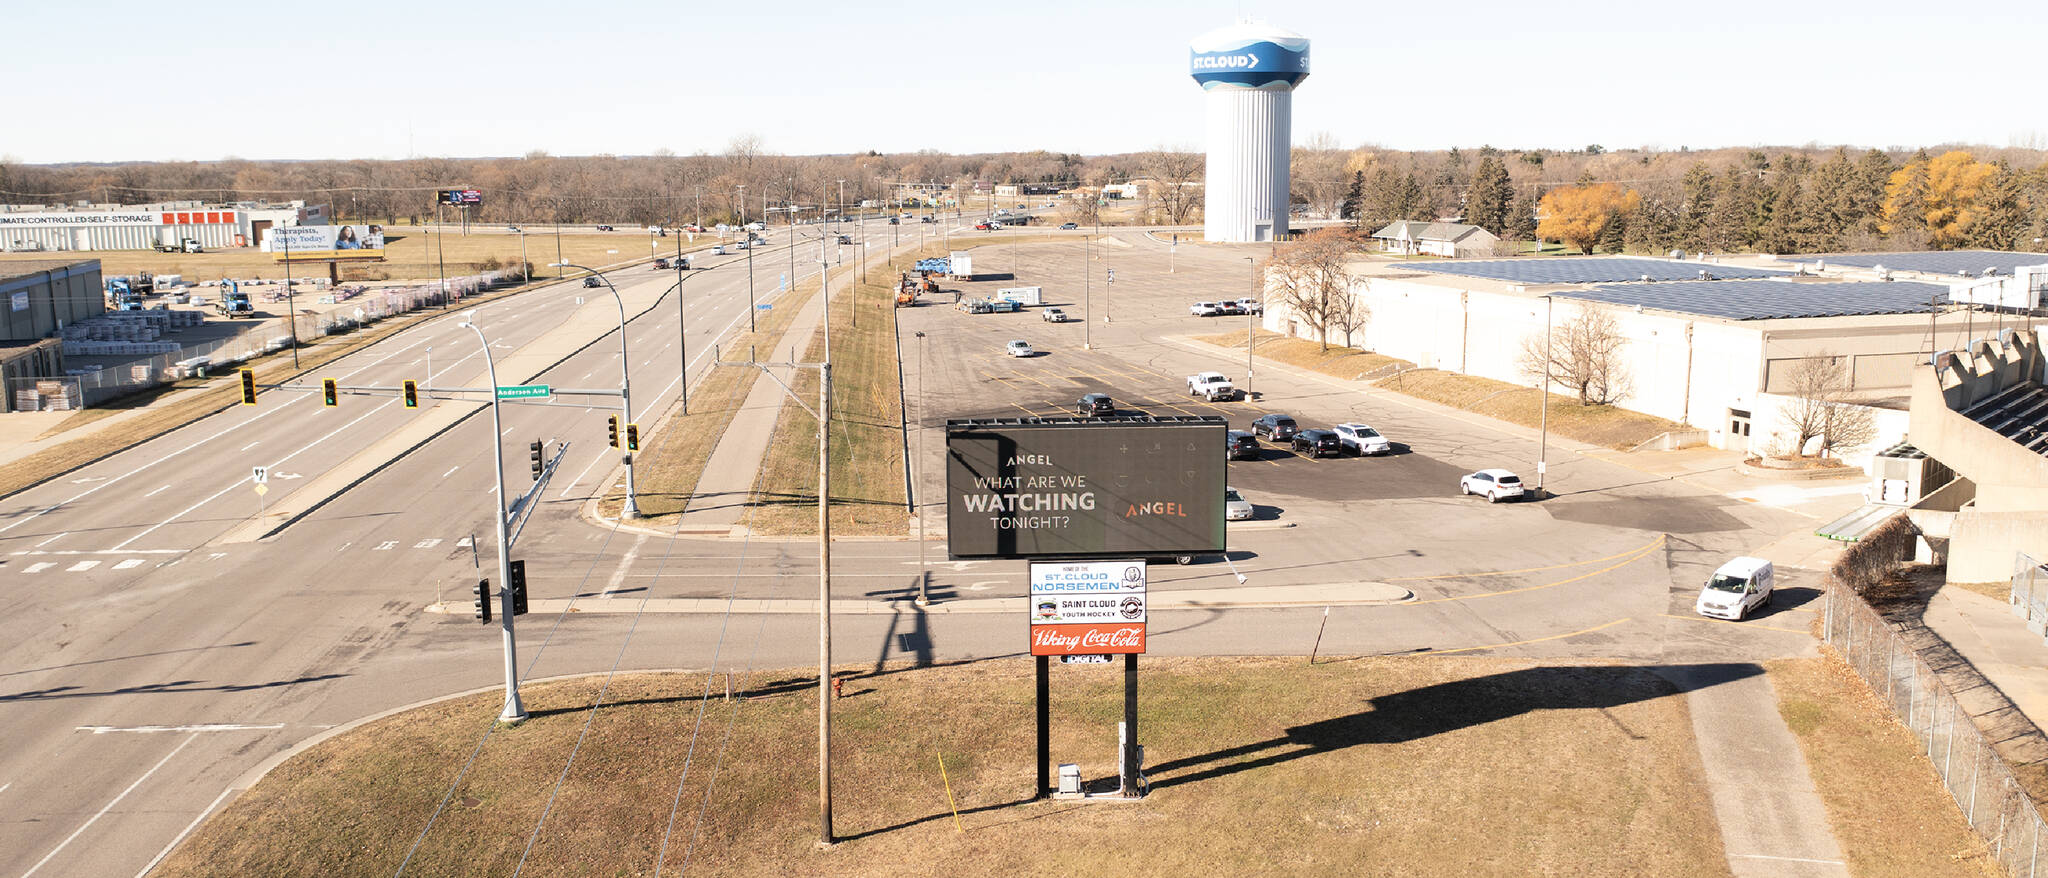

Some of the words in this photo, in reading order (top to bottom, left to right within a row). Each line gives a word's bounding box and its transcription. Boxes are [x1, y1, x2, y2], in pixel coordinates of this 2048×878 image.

[27, 216, 87, 224] CONTROLLED
[87, 215, 153, 223] SELF-STORAGE
[1006, 455, 1053, 466] ANGEL
[974, 476, 1022, 489] WHAT
[1027, 476, 1057, 488] ARE
[1060, 475, 1086, 488] WE
[963, 492, 1095, 512] WATCHING
[1125, 502, 1187, 518] ANGEL
[990, 516, 1070, 529] TONIGHT?
[1033, 582, 1119, 591] NORSEMEN
[1062, 600, 1086, 608] SAINT
[1089, 600, 1116, 608] CLOUD
[1033, 629, 1081, 651] Viking
